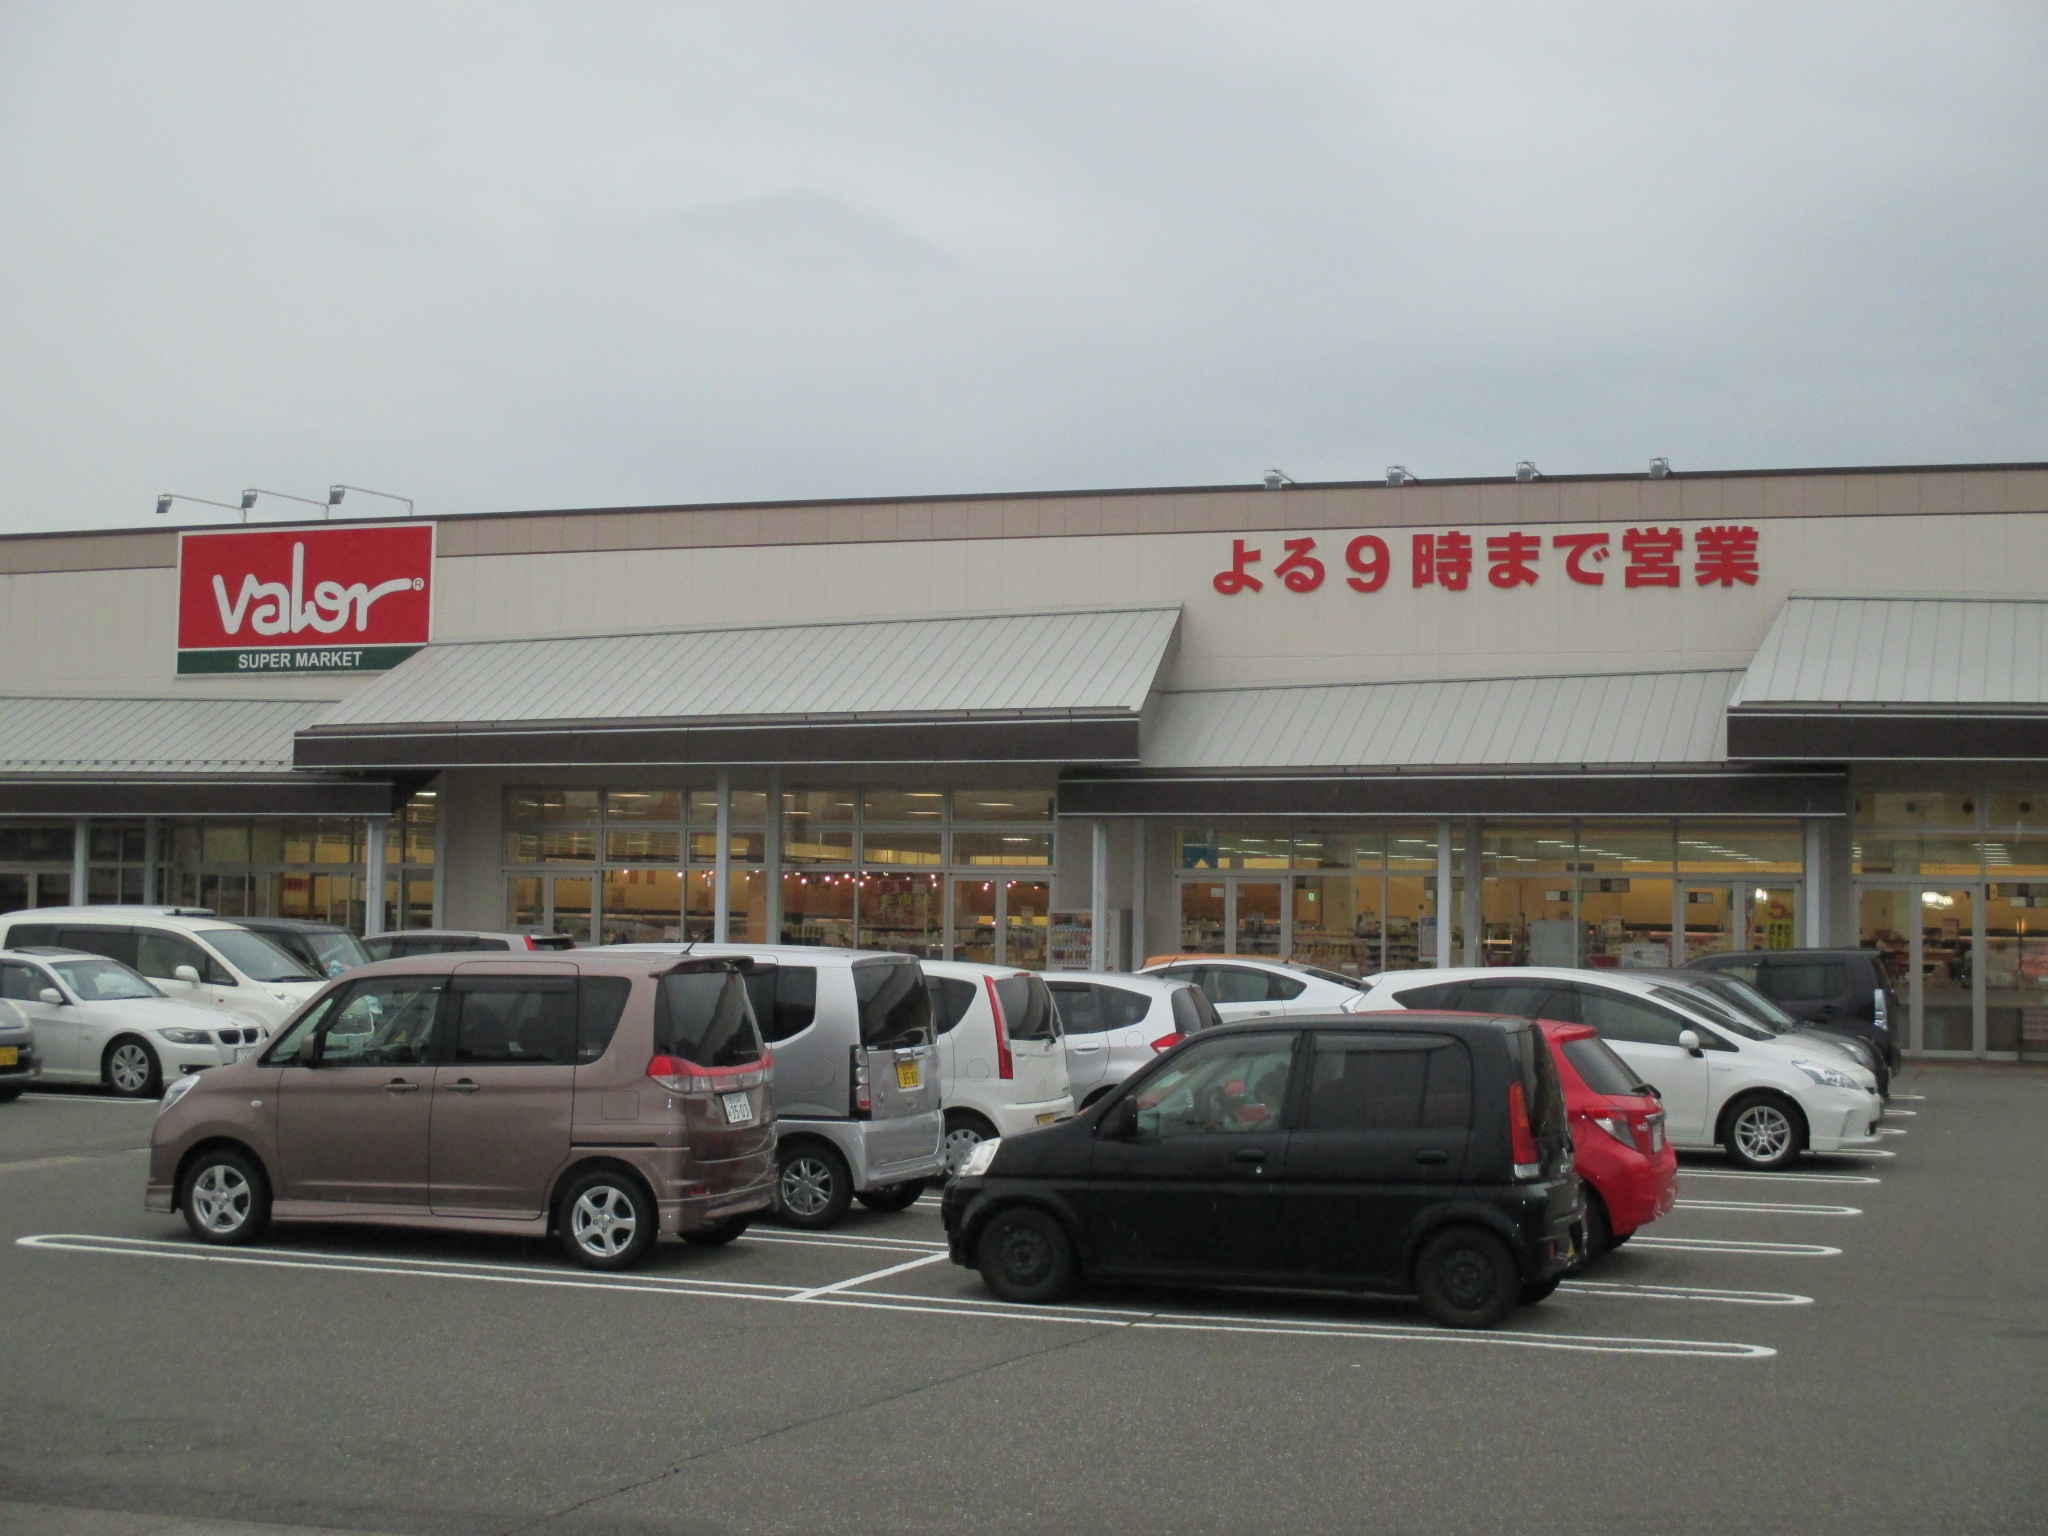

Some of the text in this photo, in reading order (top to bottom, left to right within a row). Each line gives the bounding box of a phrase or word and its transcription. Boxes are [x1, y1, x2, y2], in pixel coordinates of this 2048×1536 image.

[1212, 525, 1761, 596] よる9時まで営業
[238, 651, 363, 669] SUPER MARKET
